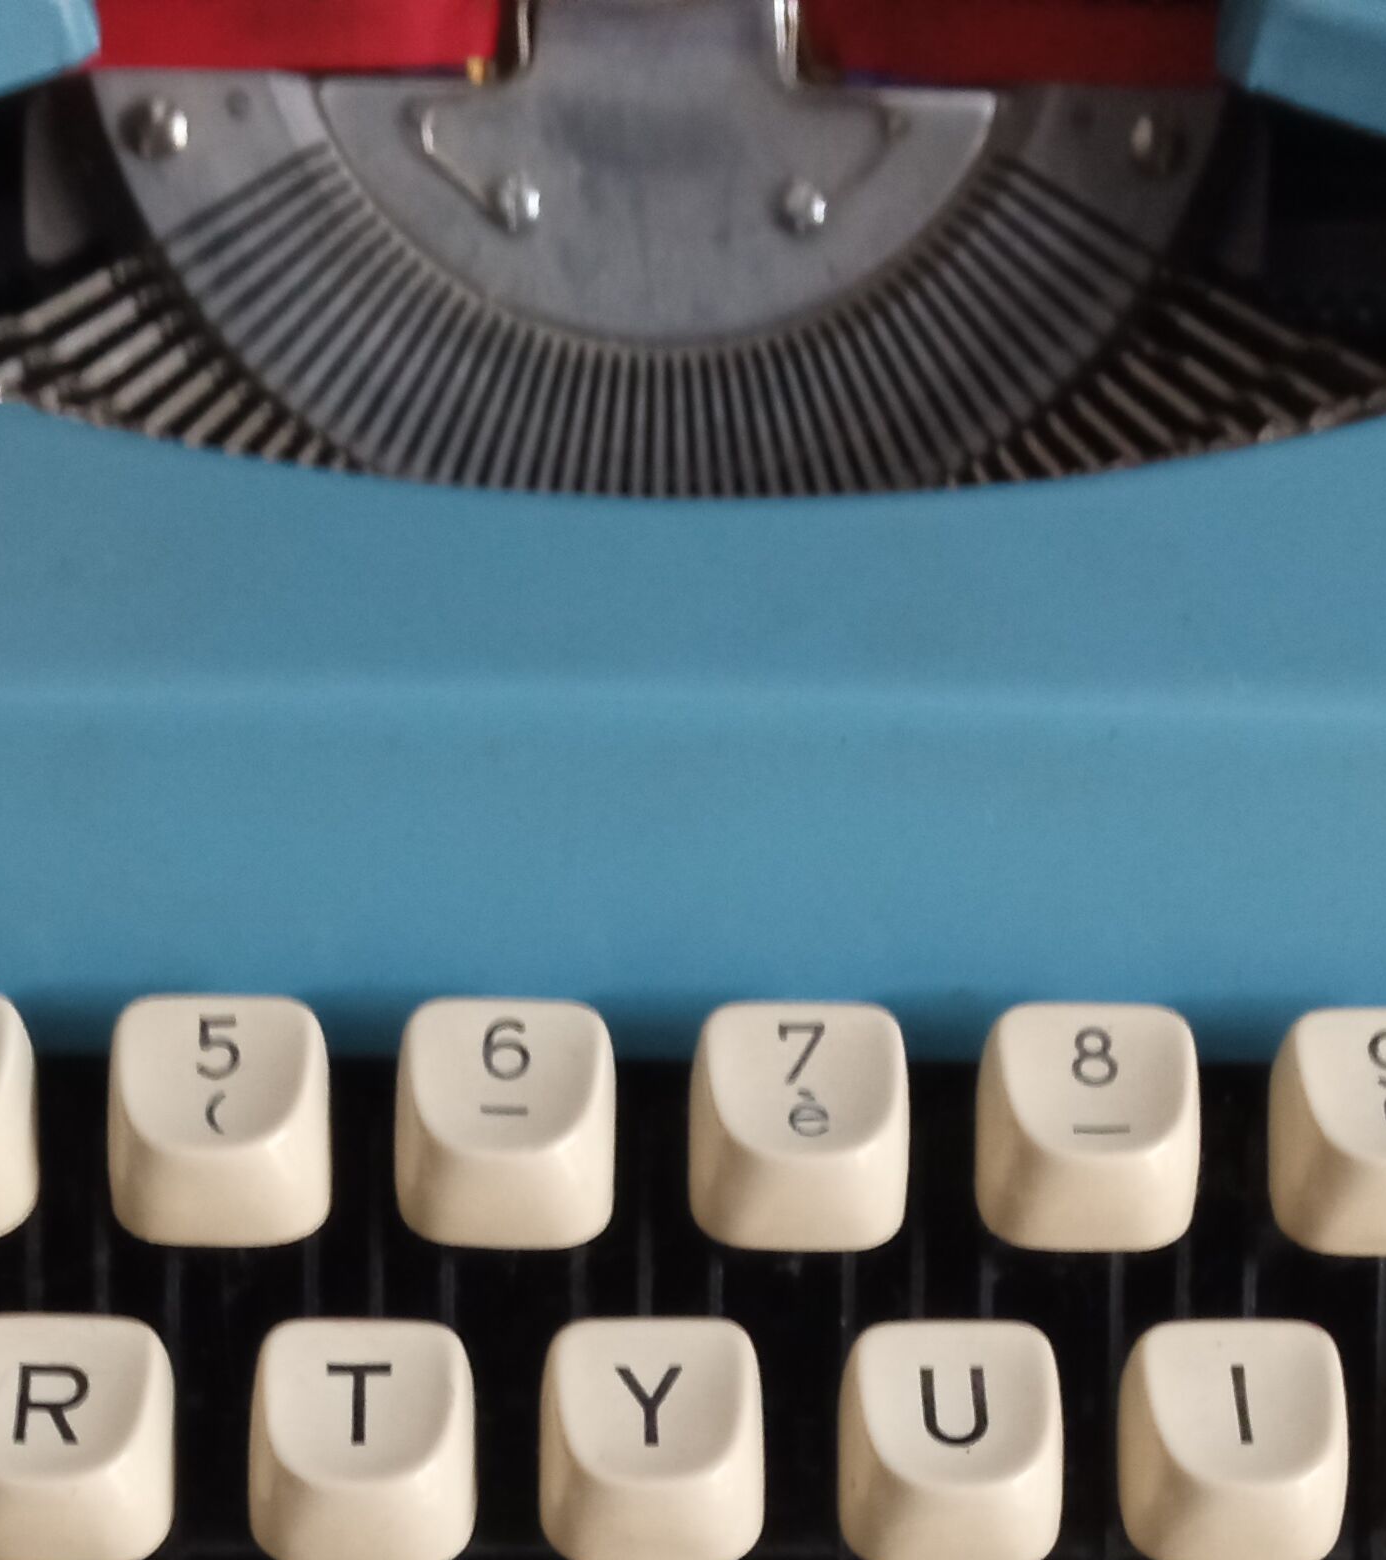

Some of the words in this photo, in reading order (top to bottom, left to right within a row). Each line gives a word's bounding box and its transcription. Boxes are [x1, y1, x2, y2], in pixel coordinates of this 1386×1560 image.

[196, 1015, 241, 1081] 5
[482, 1018, 531, 1081] 6
[777, 1021, 826, 1085] 7
[1071, 1026, 1119, 1088] 8
[204, 1092, 226, 1135] (
[12, 1362, 90, 1445] R
[326, 1362, 393, 1446] T
[614, 1364, 683, 1447] Y
[919, 1365, 989, 1448] U
[1230, 1363, 1254, 1445] I
